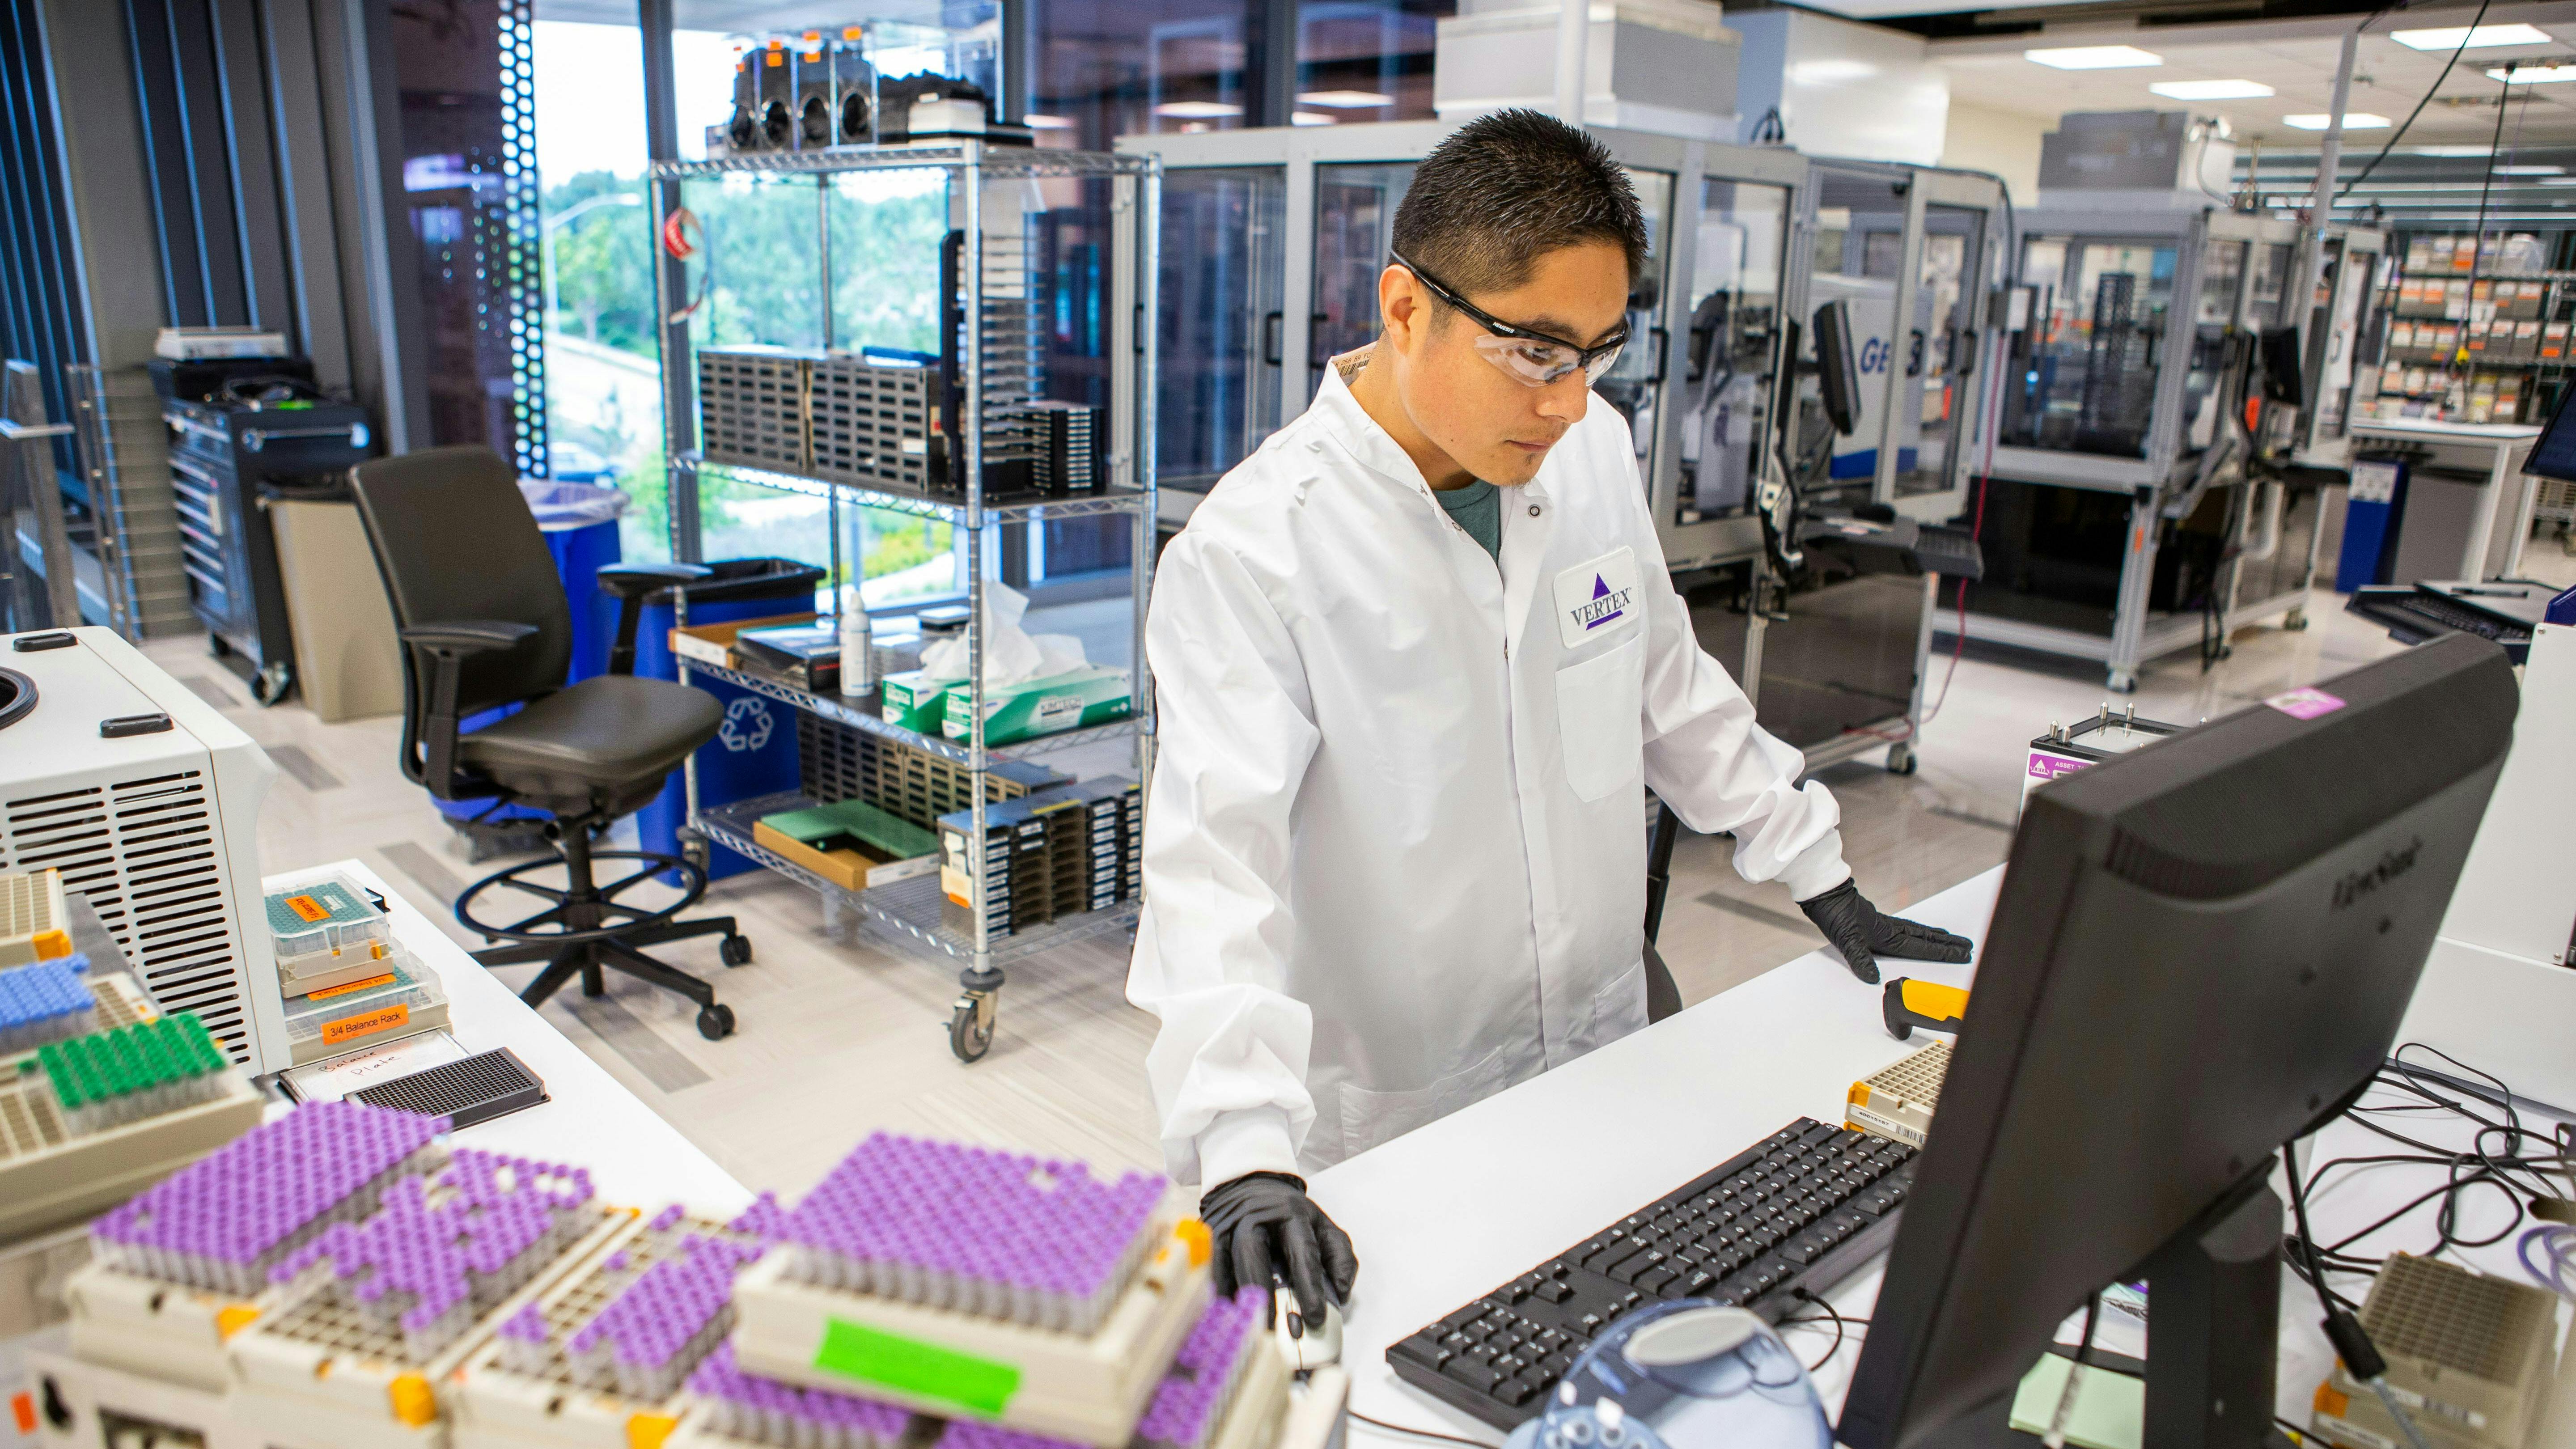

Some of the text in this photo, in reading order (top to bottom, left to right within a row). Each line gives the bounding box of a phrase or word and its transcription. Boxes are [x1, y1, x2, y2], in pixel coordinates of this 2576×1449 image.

[1571, 587, 1631, 626] VERTEX
[330, 1012, 401, 1037] 3/4 Balance Rack
[318, 1052, 377, 1072] Balance
[351, 1056, 401, 1076] Plate
